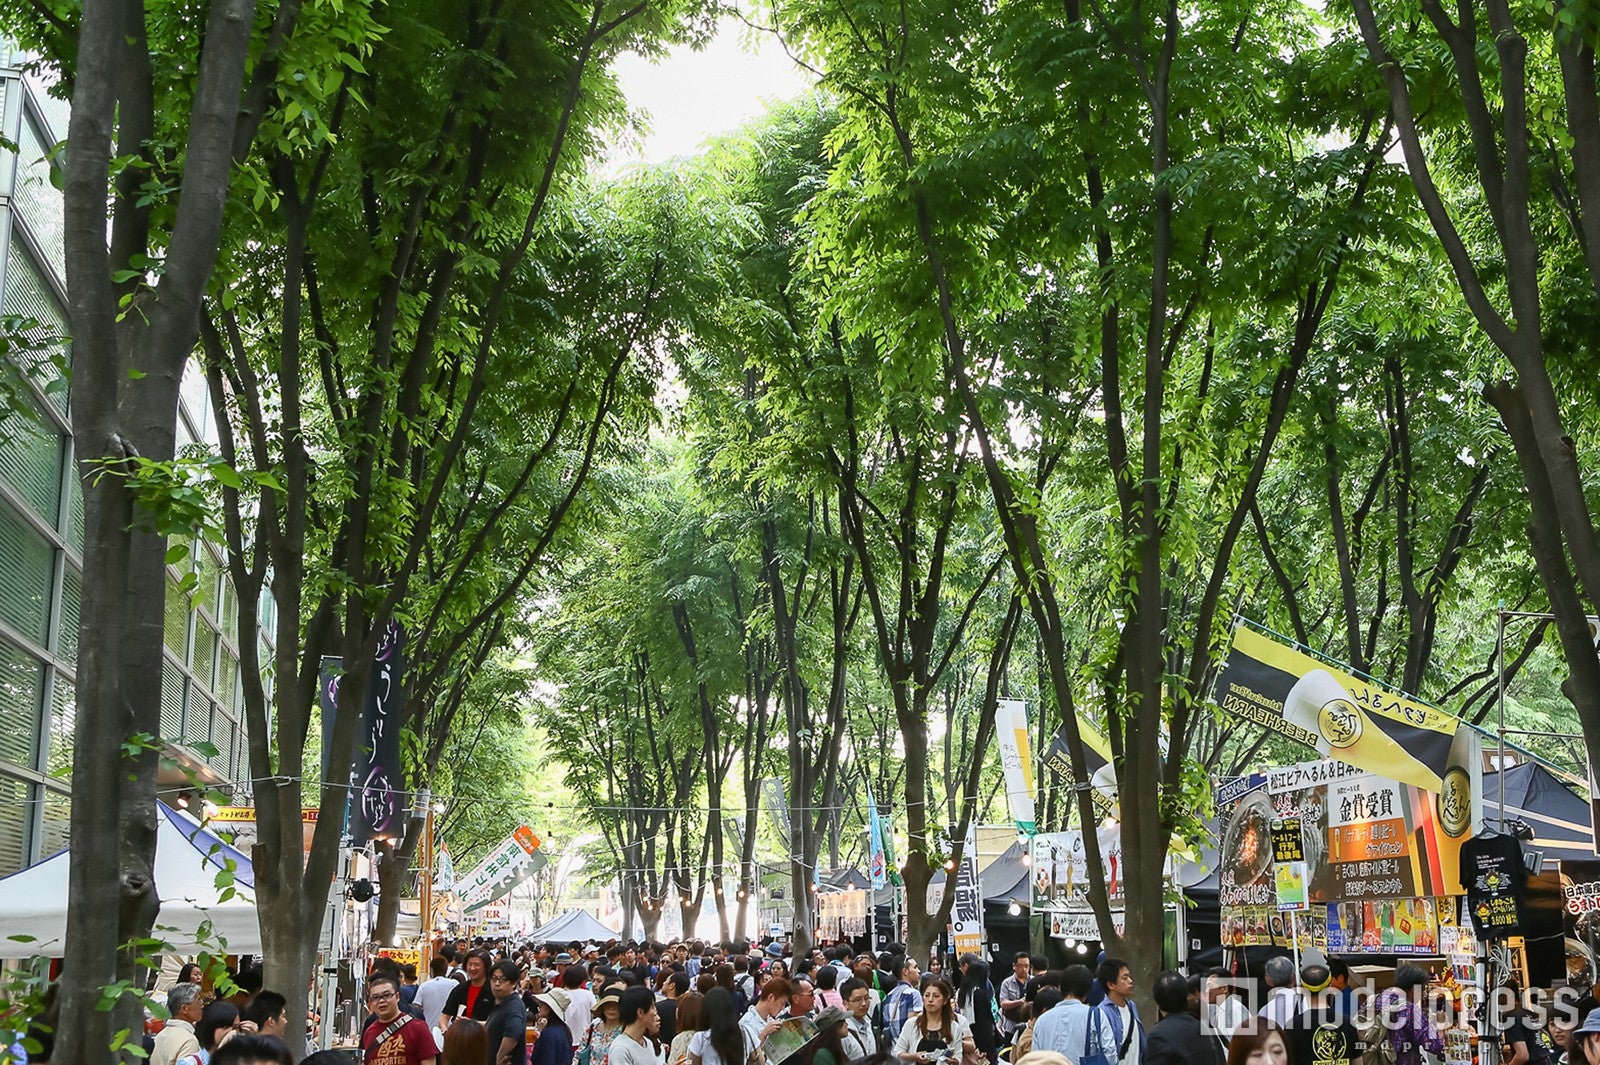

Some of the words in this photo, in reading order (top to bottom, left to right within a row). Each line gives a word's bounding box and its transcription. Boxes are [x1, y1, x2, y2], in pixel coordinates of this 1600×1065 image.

[1340, 788, 1393, 823] 金賞受賞
[483, 909, 501, 919] ER
